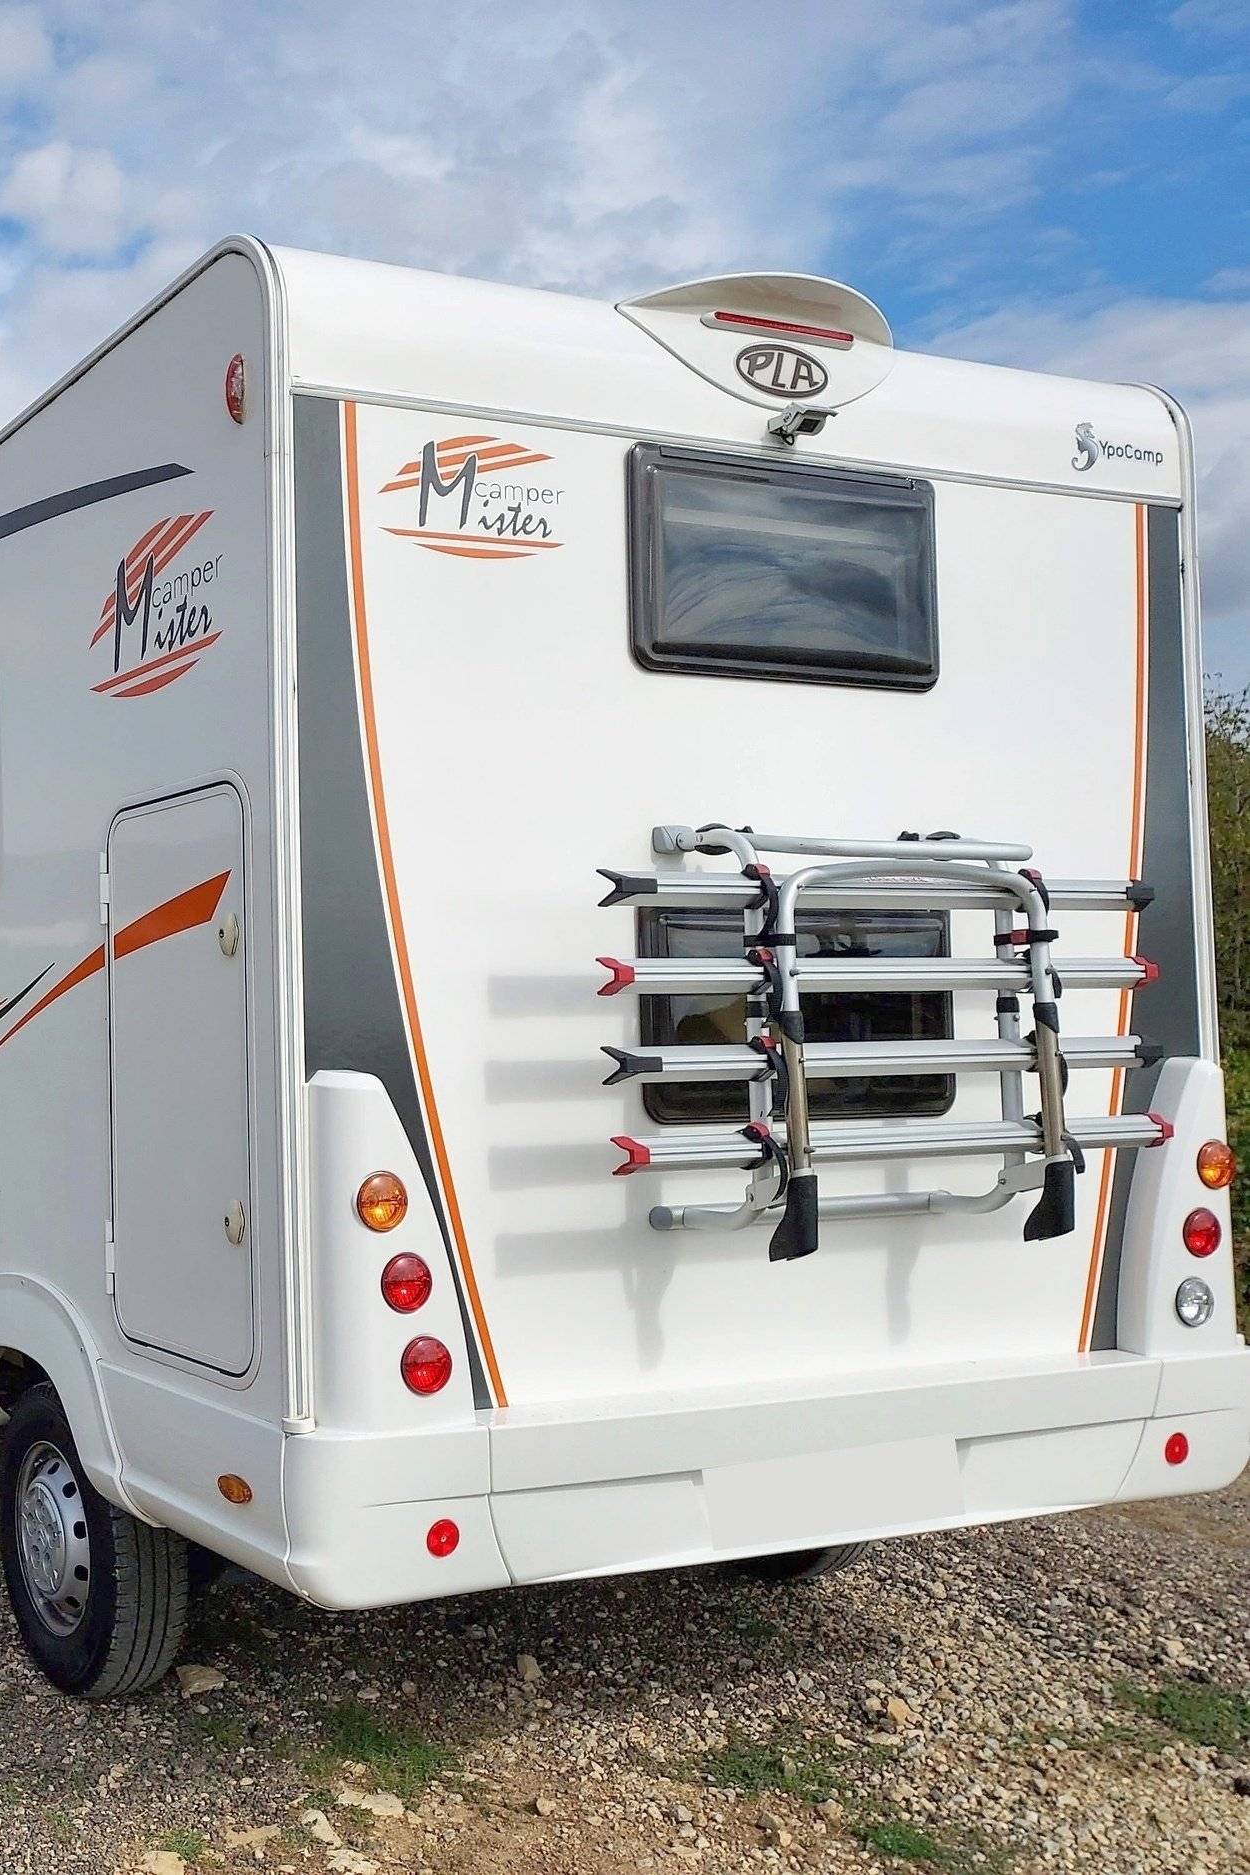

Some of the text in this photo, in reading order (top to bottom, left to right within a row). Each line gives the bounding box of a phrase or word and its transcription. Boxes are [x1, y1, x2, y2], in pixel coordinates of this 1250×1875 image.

[1098, 440, 1164, 467] YpoCamp
[418, 440, 553, 539] Mister
[473, 481, 566, 507] camper
[151, 553, 224, 609] camper
[113, 551, 213, 674] Mister
